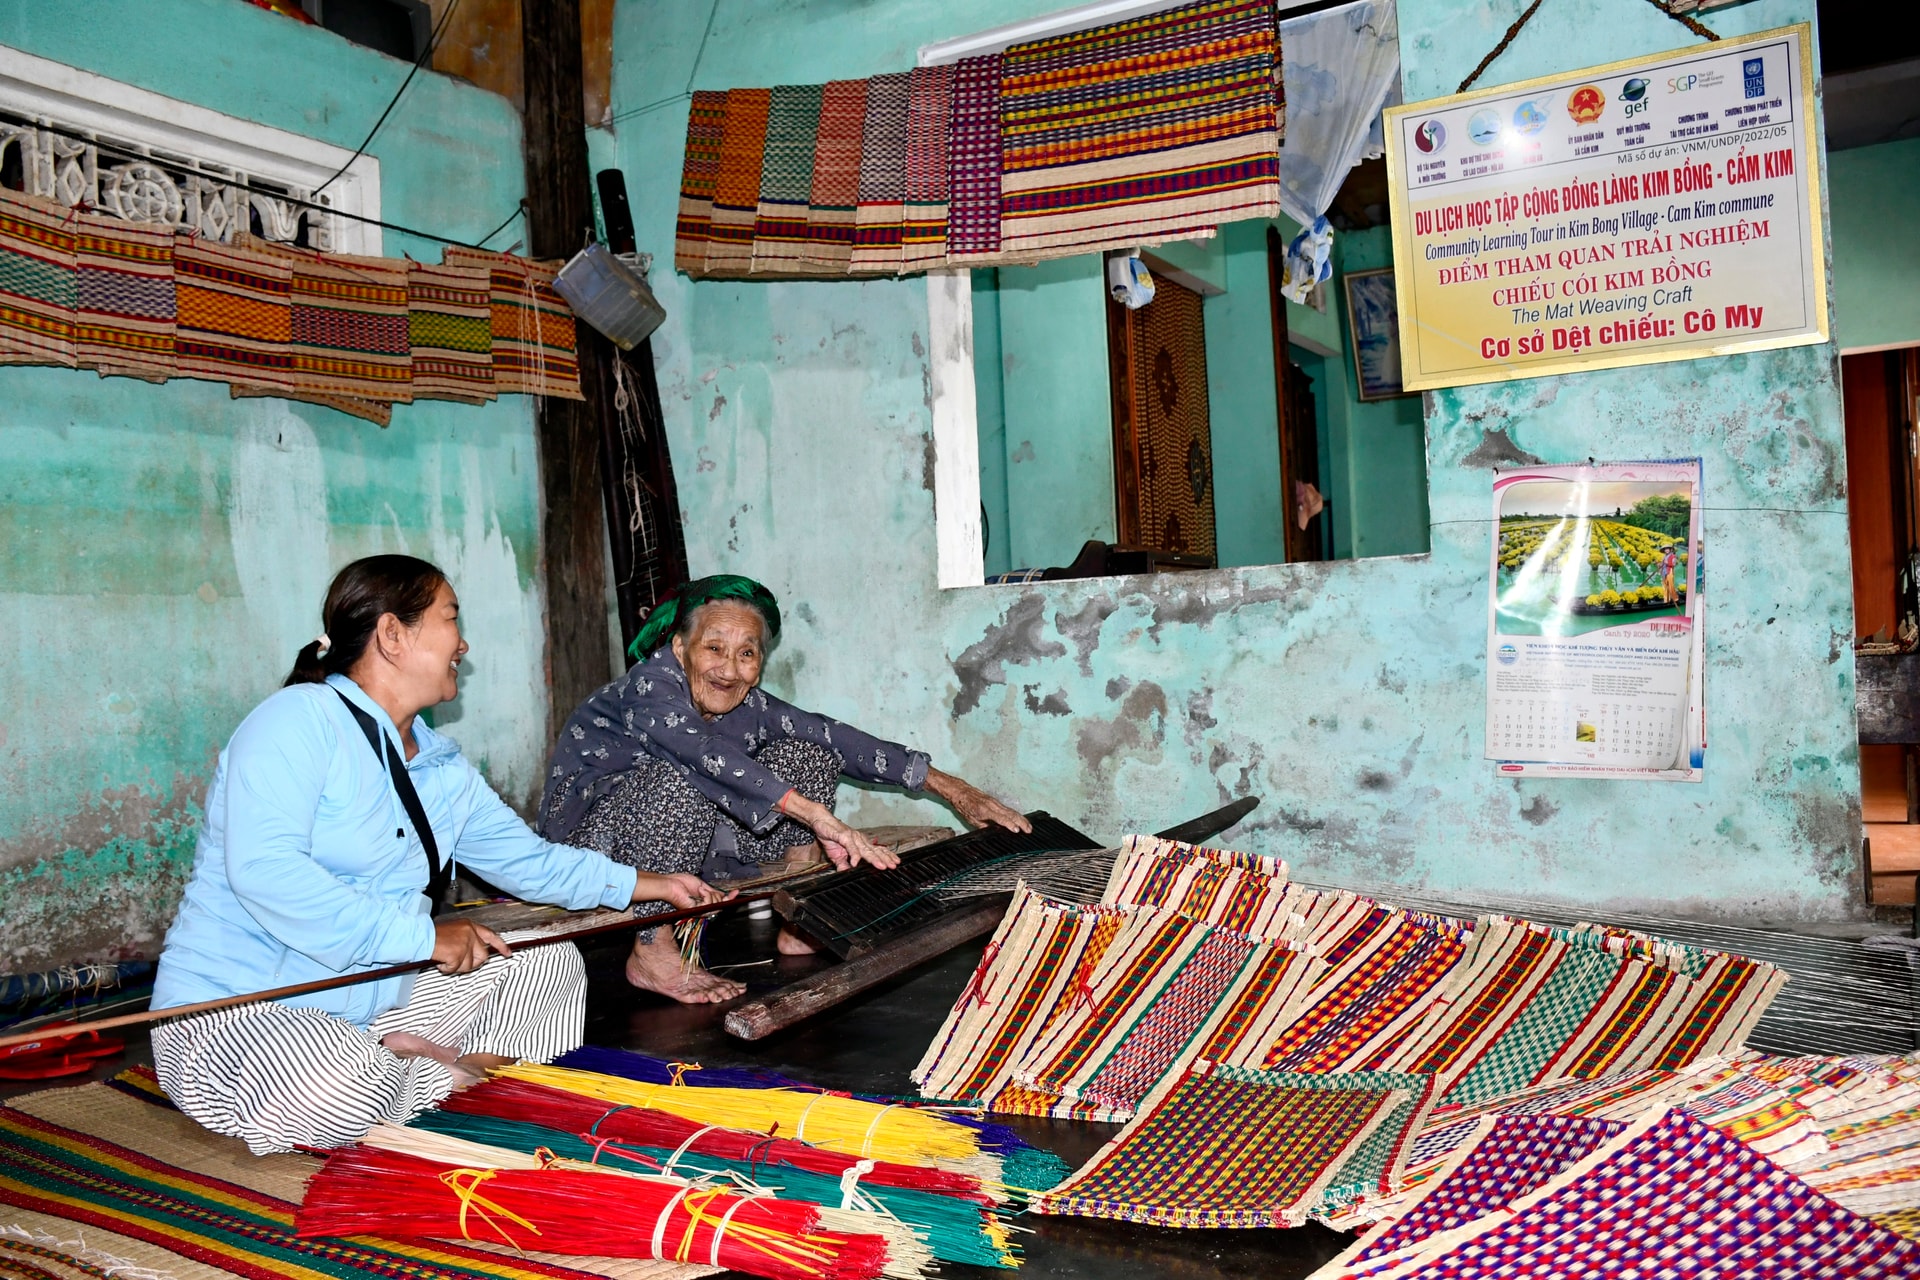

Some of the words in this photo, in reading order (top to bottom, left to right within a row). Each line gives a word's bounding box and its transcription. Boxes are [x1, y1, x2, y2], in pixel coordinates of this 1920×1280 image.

[1624, 97, 1649, 119] gef
[1668, 74, 1697, 94] SGP
[1618, 153, 1633, 164] Mã
[1636, 148, 1646, 161] số
[1648, 148, 1662, 159] dự
[1664, 146, 1680, 157] án:
[1682, 126, 1787, 154] VNM/UNDP/2022/05
[1415, 210, 1432, 236] DU
[1435, 204, 1463, 237] LỊCH
[1466, 200, 1492, 231] HỌC
[1494, 192, 1519, 226] TẬP
[1523, 186, 1559, 222] CỘNG
[1562, 177, 1599, 212] ĐỒNG
[1602, 173, 1639, 206] LÀNG
[1642, 170, 1670, 199] KIM
[1673, 157, 1713, 194] BỒNG
[1727, 146, 1760, 185] CẨM
[1764, 148, 1794, 180] KIM
[1426, 236, 1480, 260] Community
[1483, 230, 1528, 252] Learning
[1530, 226, 1554, 244] Tour
[1556, 223, 1566, 240] in
[1569, 220, 1589, 238] Kim
[1592, 216, 1618, 236] Bong
[1622, 206, 1658, 232] Village
[1668, 204, 1690, 224] Cam
[1694, 200, 1717, 219] Kim
[1719, 193, 1774, 216] commune
[1438, 257, 1488, 285] ĐIỂM
[1494, 252, 1552, 277] THAM
[1558, 243, 1616, 269] QUAN
[1622, 230, 1673, 258] TRẢI
[1680, 219, 1771, 250] NGHIỆM
[1492, 276, 1556, 306] CHIẾU
[1562, 272, 1598, 296] CÓI
[1605, 269, 1644, 292] KIM
[1652, 256, 1712, 284] BỒNG
[1512, 308, 1540, 325] The
[1544, 302, 1574, 321] Mat
[1579, 294, 1647, 316] Weaving
[1652, 286, 1693, 306] Craft
[1481, 336, 1510, 360] Cơ
[1518, 328, 1544, 356] sở
[1552, 326, 1592, 353] Dệt
[1598, 312, 1676, 345] chiếu:
[1683, 308, 1716, 334] Cô
[1724, 304, 1764, 330] My
